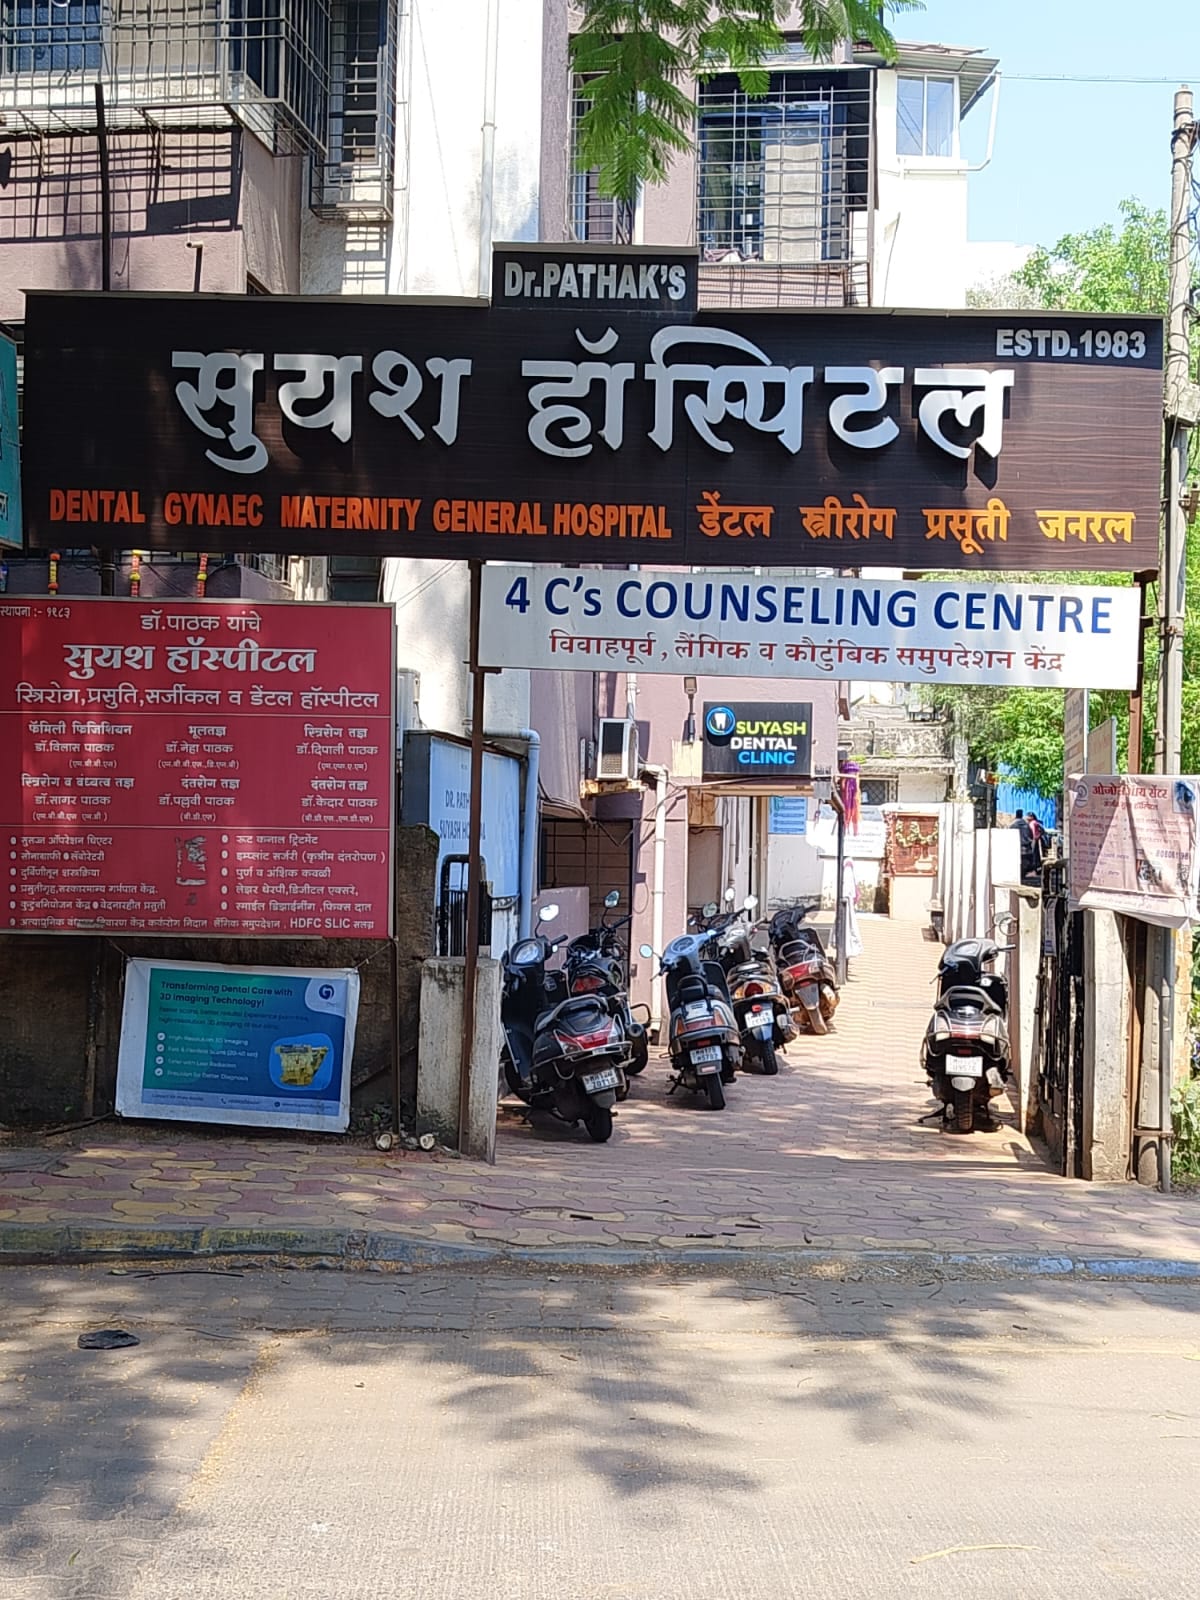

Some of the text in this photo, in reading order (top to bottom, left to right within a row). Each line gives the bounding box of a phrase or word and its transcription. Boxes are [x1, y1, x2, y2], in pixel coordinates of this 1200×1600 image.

[504, 261, 687, 301] Dr.PATHAK'S
[995, 328, 1147, 360] ESTD.1983
[171, 324, 1016, 475] सुयश हॉस्पिटल
[49, 488, 146, 525] DENTAL
[163, 491, 264, 528] GYNAEC
[280, 494, 422, 532] MATERNITY
[432, 498, 549, 537] GENERAL
[552, 502, 673, 540] HOSPITAL
[696, 491, 1136, 555] डेंटल स्त्रीरोग प्रसूती जनरल
[0, 605, 32, 618] स्थापना
[505, 575, 1113, 634] 4 C's COUNSELING CENTRE
[139, 609, 262, 633] डॉ.पाठक यांचे
[63, 636, 318, 680] सुयश हॉस्पीटल
[674, 631, 751, 660] लैंगिक
[759, 643, 778, 661] व
[784, 636, 890, 672] कौटुंबिक
[896, 642, 1016, 675] समुपदेशन
[1023, 645, 1066, 673] केंद्र
[228, 689, 243, 706] व
[250, 684, 293, 708] डेंटल
[300, 686, 380, 710] हॉस्पीटल
[735, 720, 807, 736] SUYASH
[84, 742, 115, 754] पाठक
[203, 743, 234, 754] पाठक
[347, 745, 379, 756] पाठक
[730, 736, 798, 751] DENTAL
[737, 751, 796, 765] CLINIC
[64, 777, 73, 788] व
[180, 774, 217, 790] दंतरोग
[310, 775, 347, 792] दंतरोग
[80, 795, 112, 807] पाठक
[204, 796, 236, 807] पाठक
[347, 798, 379, 808] पाठक
[456, 791, 470, 809] PATH
[256, 869, 264, 878] व
[289, 917, 351, 930] HDFC SLIC
[160, 980, 293, 997] Transforming Dental Care with
[159, 992, 172, 1001] 3D
[172, 993, 211, 1004] Imaging
